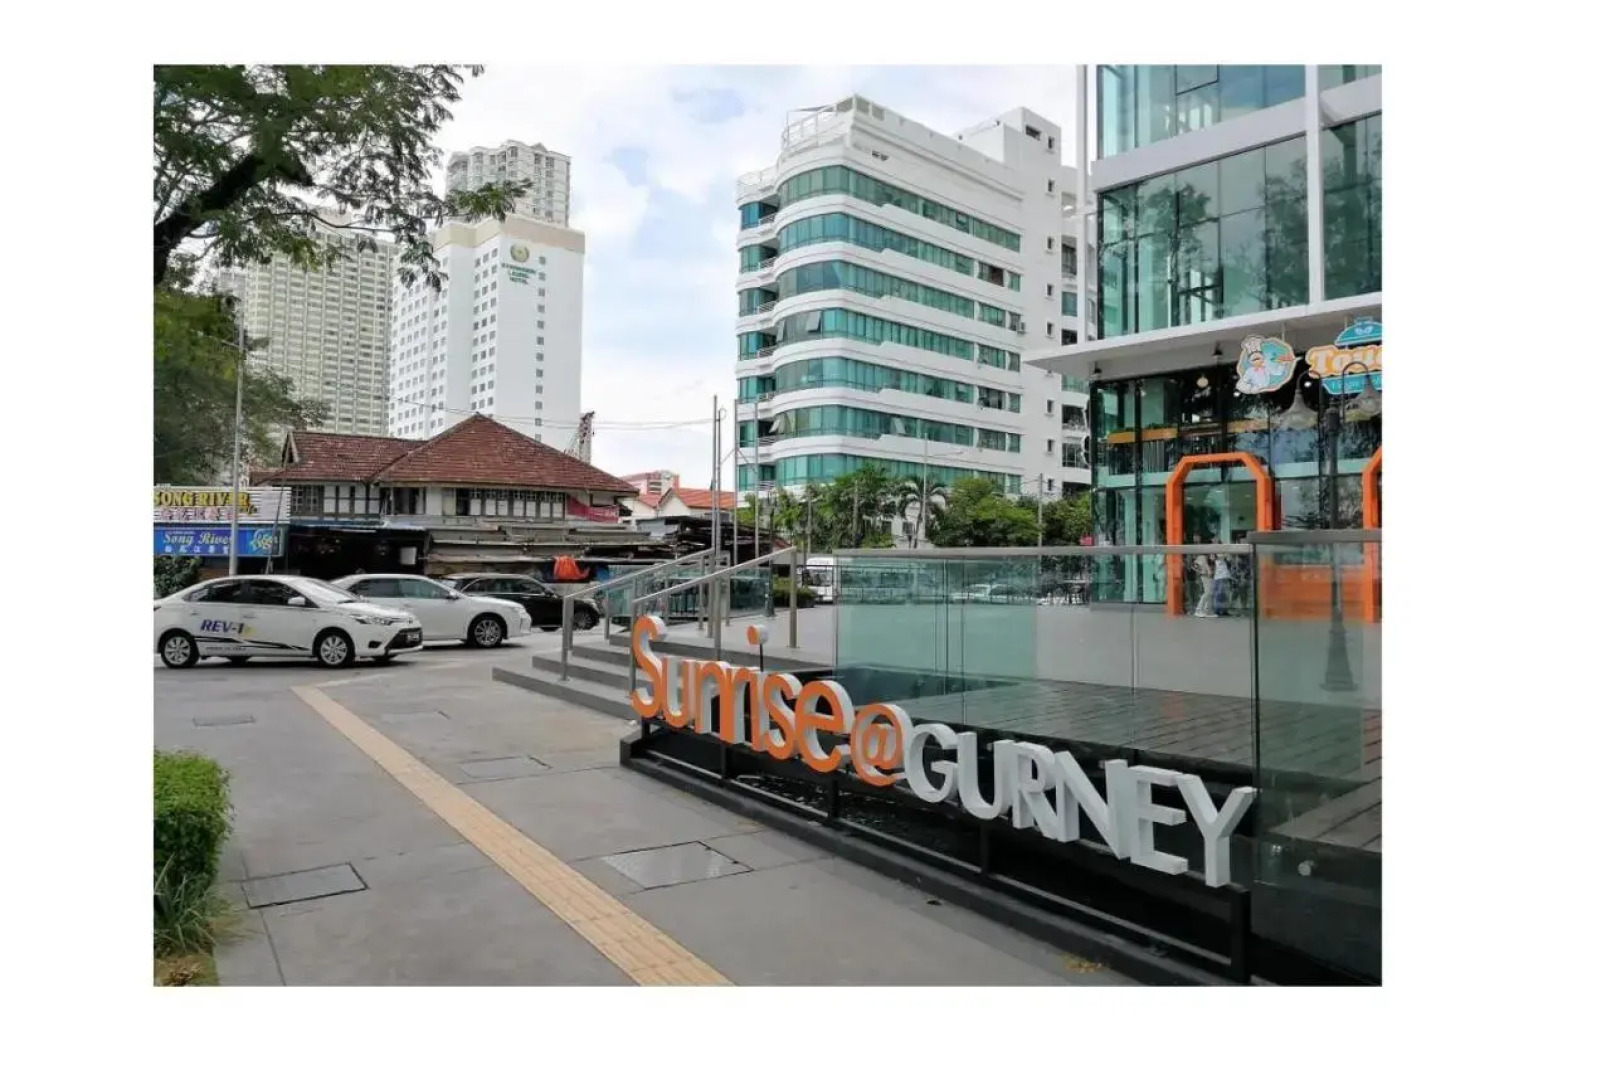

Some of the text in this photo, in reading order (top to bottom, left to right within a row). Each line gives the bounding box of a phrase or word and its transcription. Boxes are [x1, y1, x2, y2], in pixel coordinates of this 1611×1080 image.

[199, 491, 249, 507] RIVER
[163, 533, 194, 547] Song
[200, 618, 245, 634] REV-1
